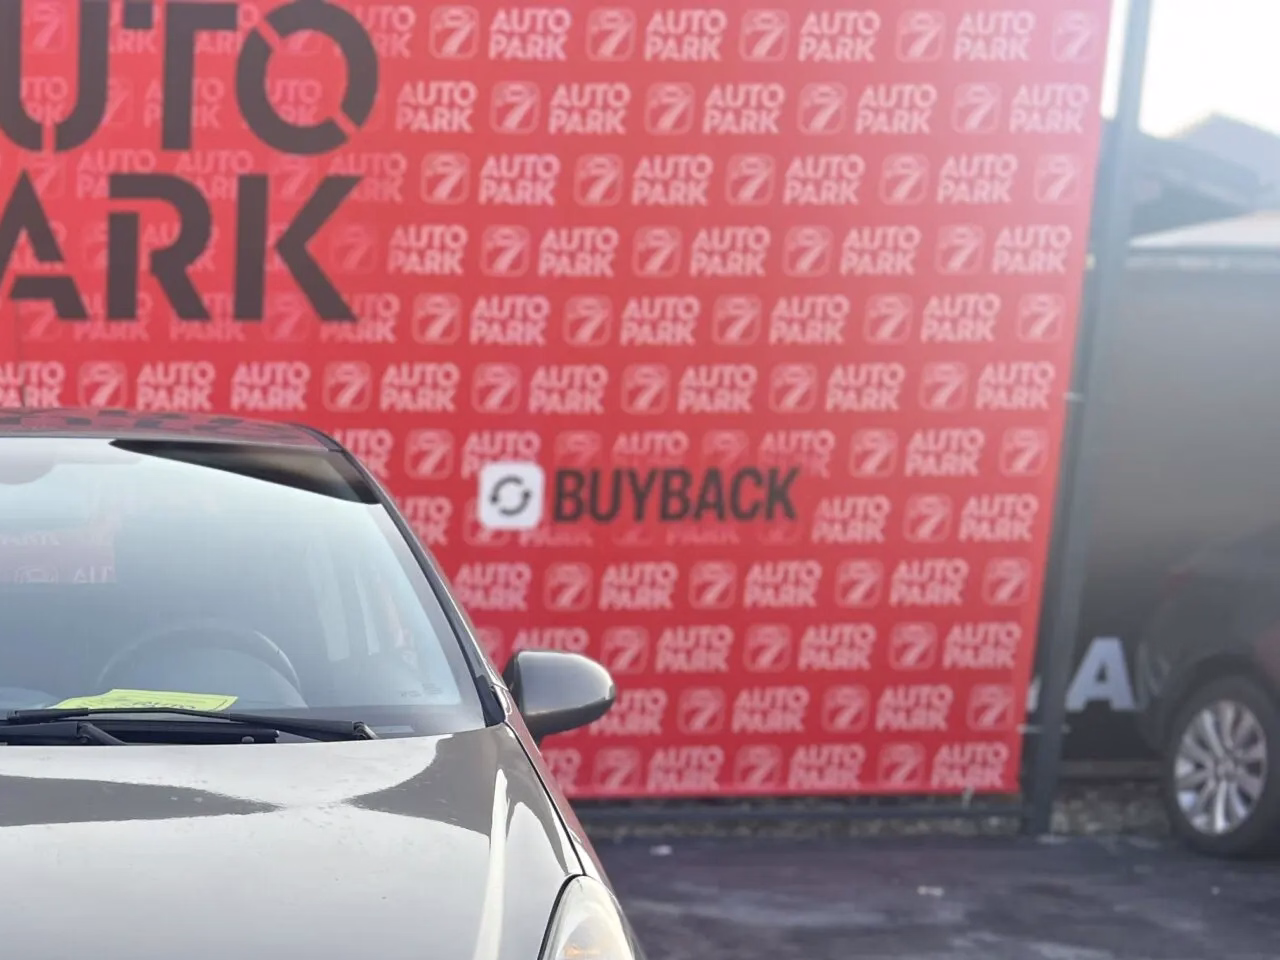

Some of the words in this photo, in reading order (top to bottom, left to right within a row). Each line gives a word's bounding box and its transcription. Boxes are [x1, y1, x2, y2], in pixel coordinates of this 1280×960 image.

[490, 8, 572, 34] AUTO
[647, 9, 727, 35] AUTO
[801, 10, 882, 36] AUTO
[489, 33, 567, 59] PARK
[645, 34, 722, 60] PARK
[799, 35, 876, 61] PARK
[398, 81, 477, 106] AUTO
[550, 83, 631, 109] AUTO
[705, 83, 786, 109] AUTO
[858, 82, 939, 109] AUTO
[397, 105, 472, 132] PARK
[549, 108, 626, 133] PARK
[703, 108, 780, 133] PARK
[856, 108, 933, 134] PARK
[480, 154, 560, 179] AUTO
[634, 155, 714, 180] AUTO
[479, 178, 555, 204] PARK
[632, 179, 708, 205] PARK
[391, 225, 468, 249] AUTO
[540, 227, 619, 253] AUTO
[692, 226, 771, 252] AUTO
[995, 224, 1076, 250] AUTO
[389, 248, 463, 274] PARK
[538, 252, 615, 276] PARK
[690, 251, 766, 276] PARK
[993, 249, 1068, 273] PARK
[472, 295, 550, 320] AUTO
[622, 296, 700, 321] AUTO
[772, 294, 851, 320] AUTO
[470, 319, 546, 344] PARK
[620, 320, 696, 344] PARK
[769, 319, 845, 343] PARK
[137, 362, 215, 387] AUTO
[232, 362, 310, 387] AUTO
[382, 363, 460, 388] AUTO
[680, 364, 758, 389] AUTO
[978, 361, 1056, 386] AUTO
[380, 387, 455, 411] PARK
[678, 388, 752, 412] PARK
[976, 385, 1051, 408] PARK
[613, 431, 690, 457] AUTO
[760, 429, 836, 455] AUTO
[908, 428, 986, 454] AUTO
[905, 453, 980, 476] PARK
[552, 467, 800, 524] BUYBACK
[962, 493, 1039, 520] AUTO
[816, 496, 891, 521] AUTO
[812, 520, 886, 542] PARK
[959, 519, 1033, 540] PARK
[602, 562, 678, 588] AUTO
[746, 560, 822, 586] AUTO
[892, 558, 969, 585] AUTO
[599, 587, 673, 609] PARK
[744, 585, 817, 607] PARK
[890, 584, 963, 605] PARK
[657, 626, 734, 652] AUTO
[946, 622, 1023, 648] AUTO
[655, 651, 728, 672] PARK
[943, 647, 1016, 668] PARK
[878, 684, 954, 711] AUTO
[876, 710, 948, 730] PARK
[790, 744, 865, 769] AUTO
[788, 768, 860, 790] PARK
